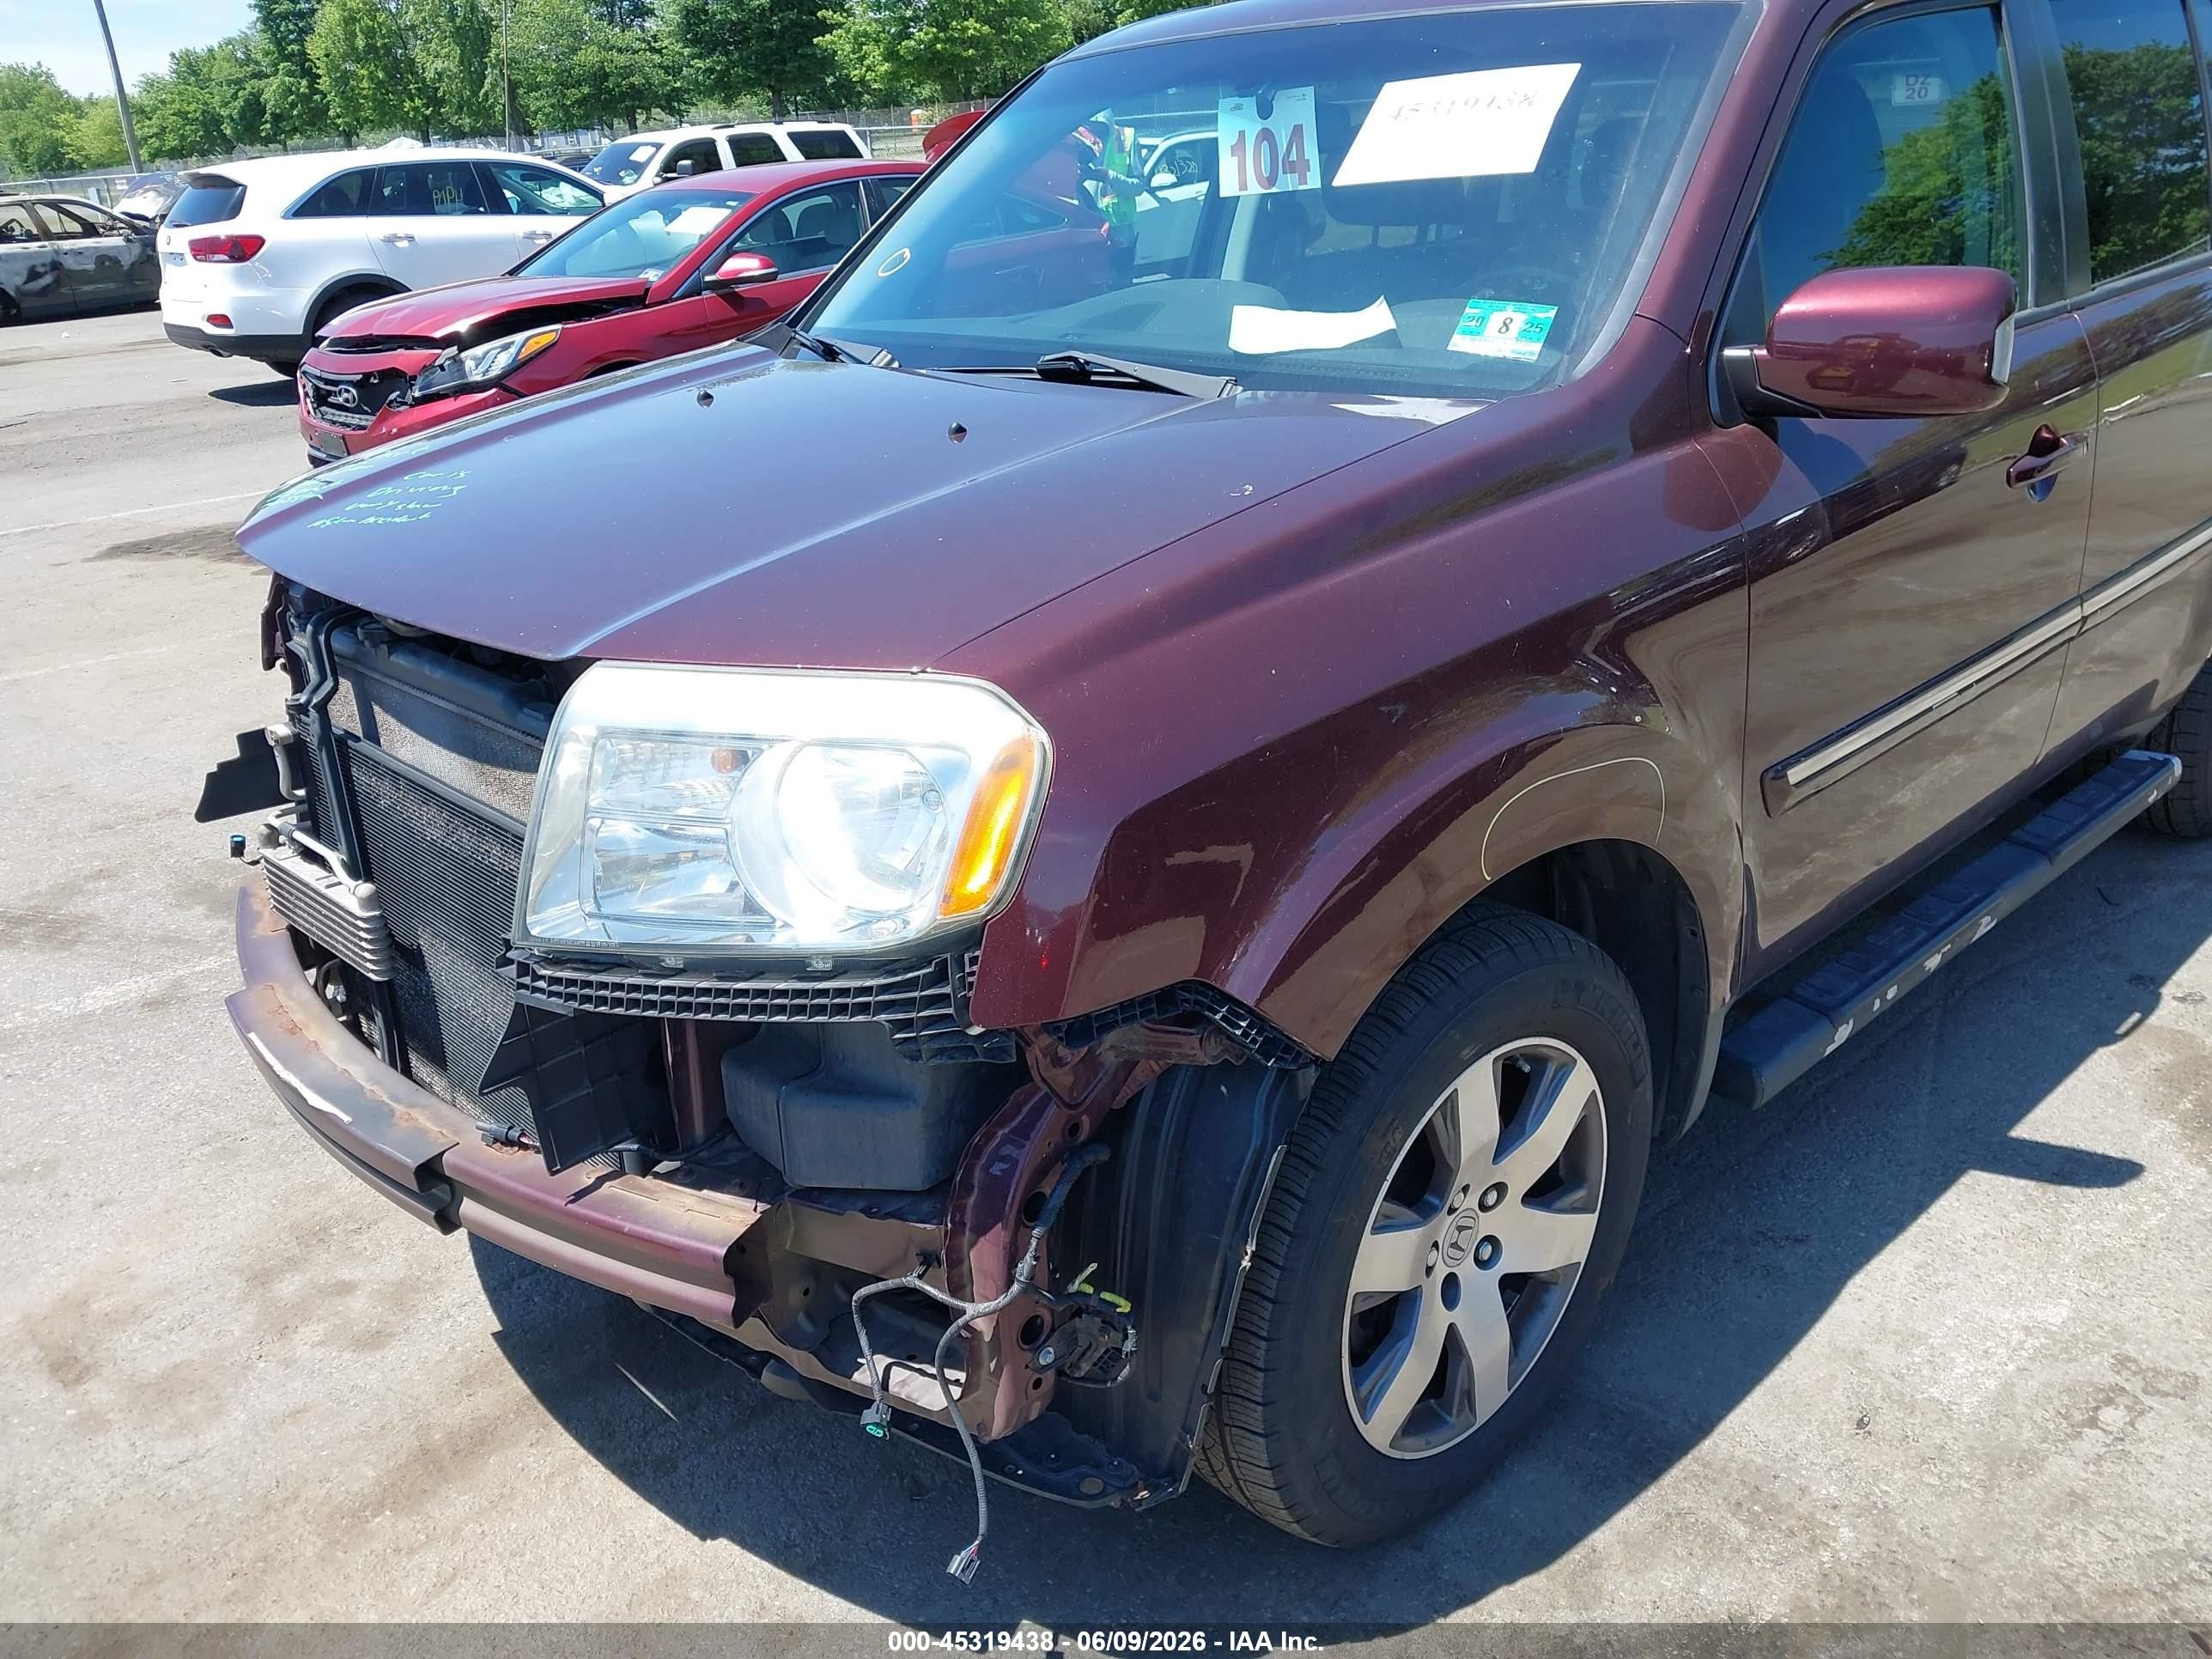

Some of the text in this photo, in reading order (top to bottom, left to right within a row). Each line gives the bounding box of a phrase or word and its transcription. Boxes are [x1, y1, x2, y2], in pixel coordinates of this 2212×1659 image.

[1230, 124, 1311, 192] 104
[1497, 316, 1514, 334] 8
[1522, 322, 1545, 334] 25
